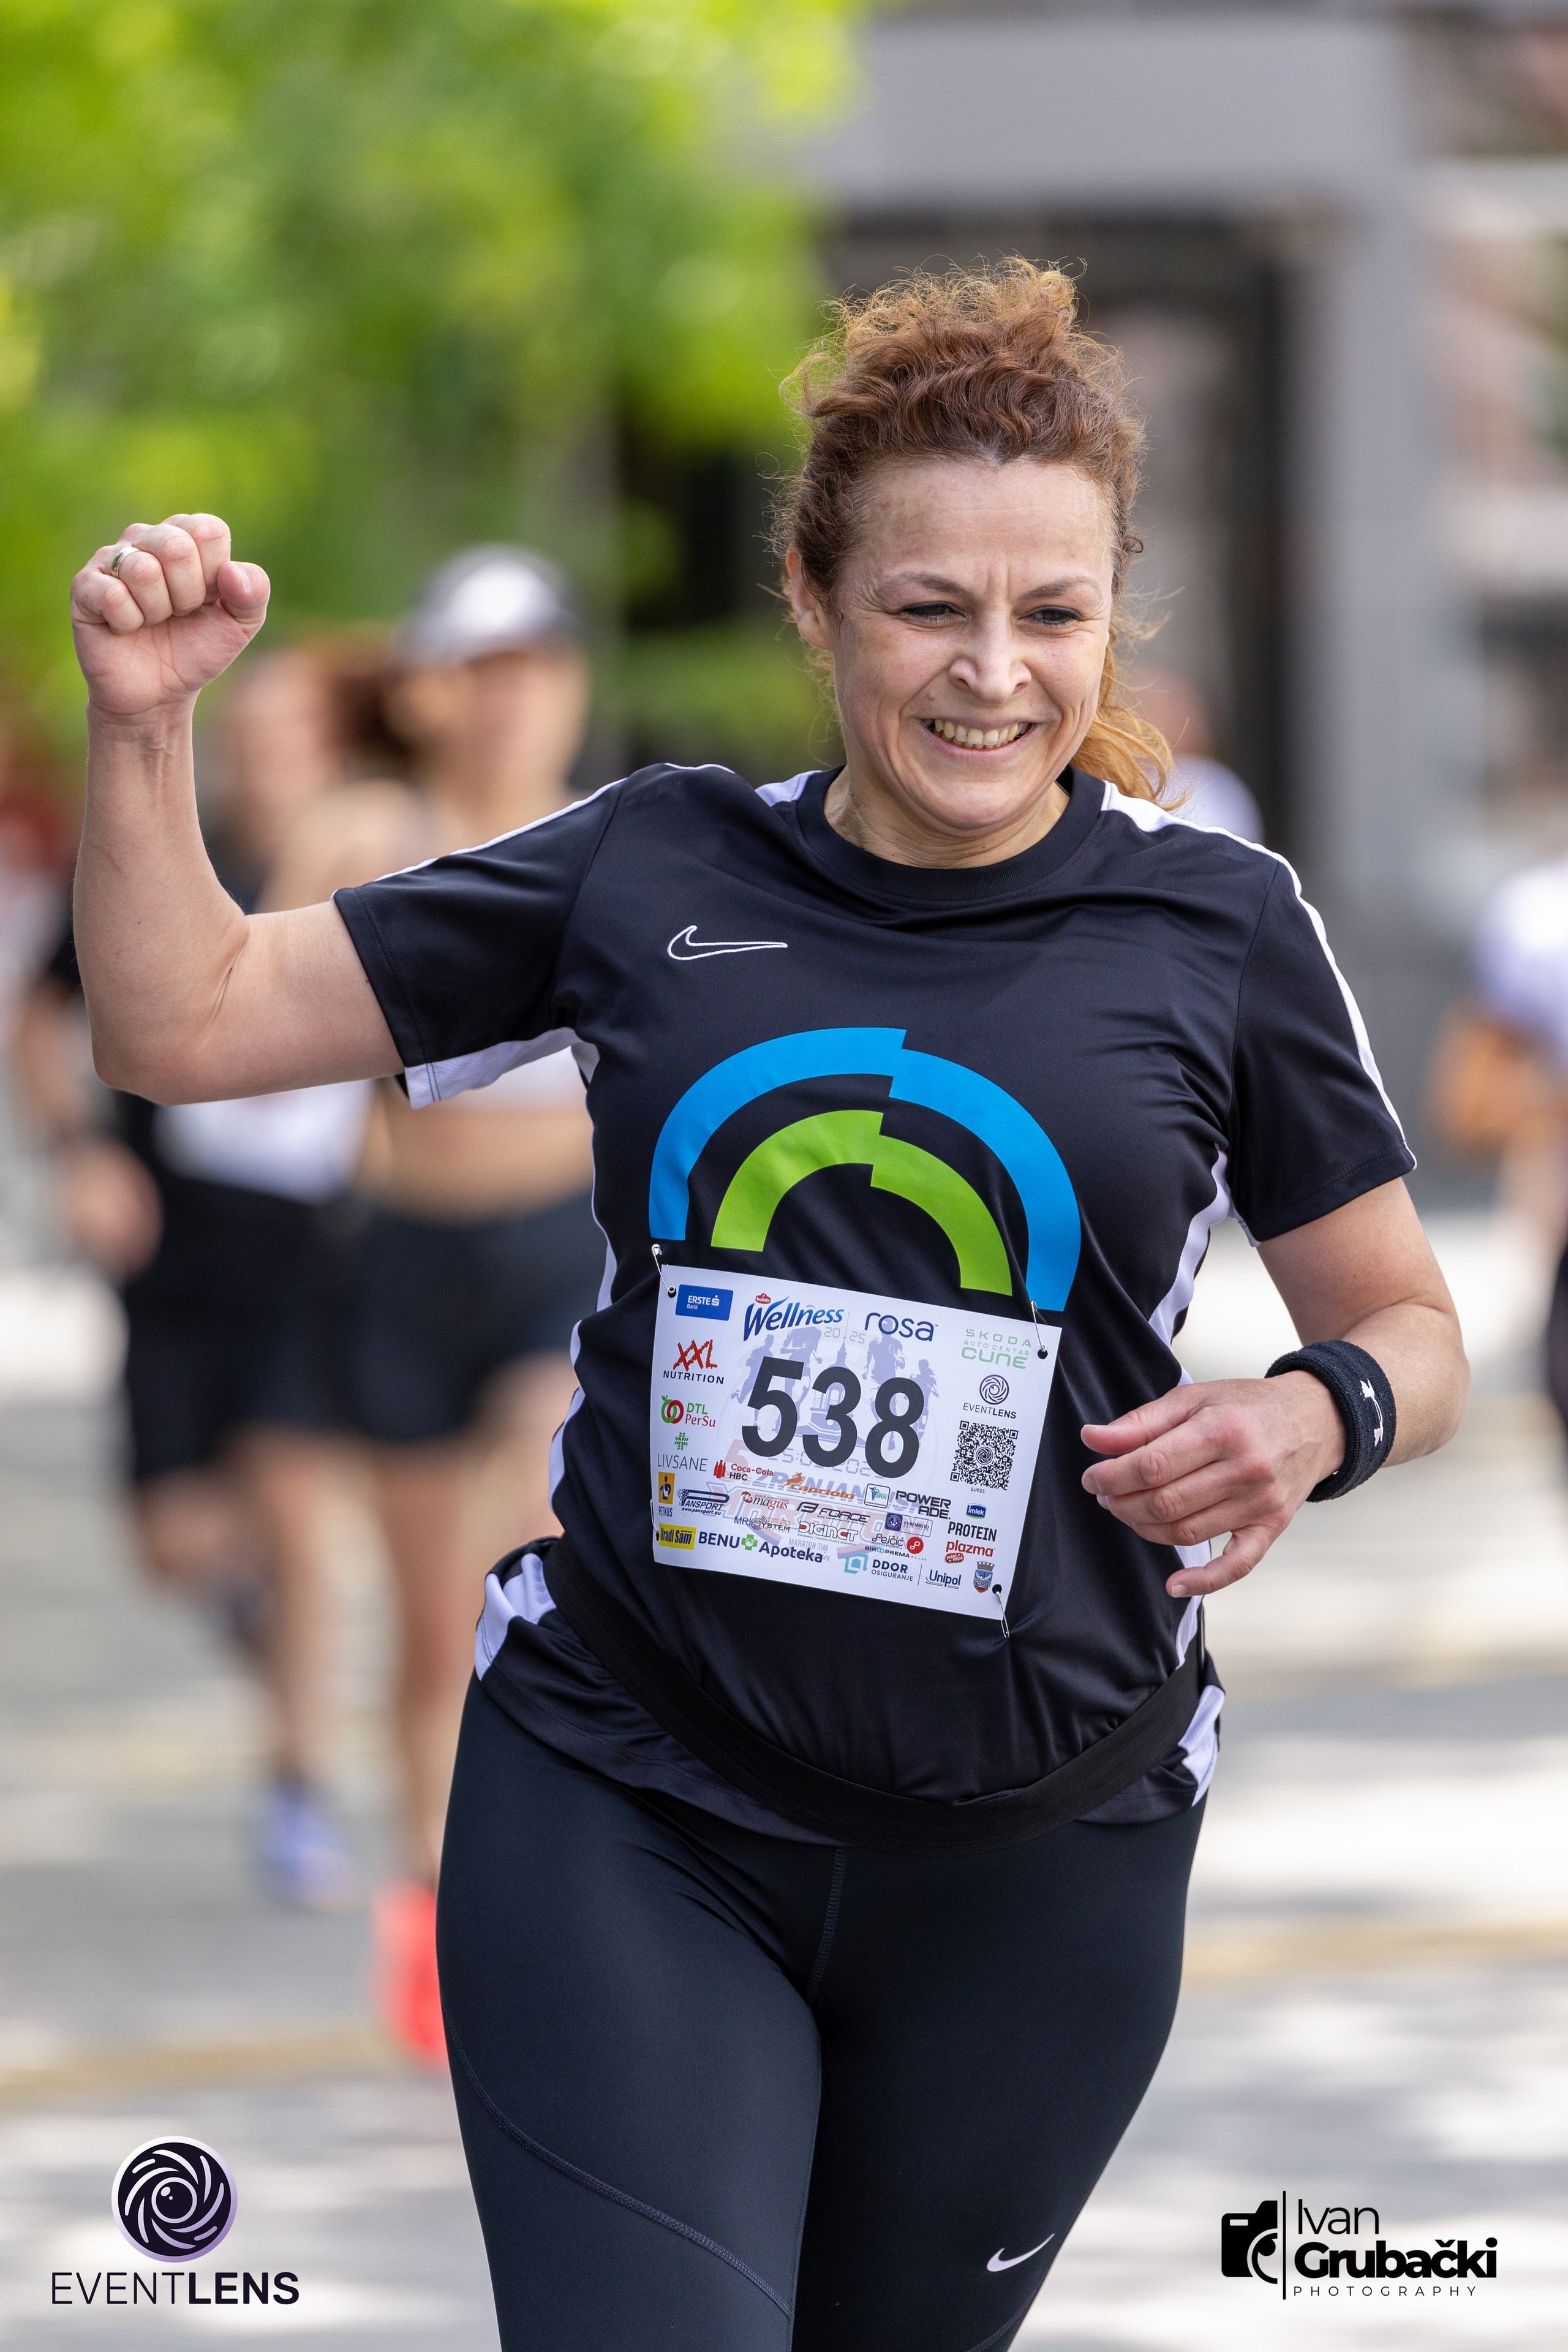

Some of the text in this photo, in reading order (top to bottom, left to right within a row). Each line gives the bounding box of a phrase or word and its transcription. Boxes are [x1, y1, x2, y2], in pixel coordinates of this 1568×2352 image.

[687, 1295, 710, 1305] ERSTE
[743, 1295, 844, 1341] Wellness
[864, 1312, 934, 1342] rosa
[673, 1339, 718, 1371] XXL
[963, 1340, 1030, 1356] AUTO CENTAR
[663, 1371, 724, 1384] NUTRITION
[687, 1403, 708, 1415] DTL
[741, 1355, 924, 1479] 538
[963, 1403, 1017, 1419] EVENTLENS
[685, 1414, 716, 1428] PerSu
[657, 1453, 708, 1472] LIVSANE
[731, 1463, 774, 1477] Coca-Cola
[729, 1472, 748, 1481] HBC
[790, 1484, 855, 1499] capriolo
[895, 1490, 951, 1509] POWER
[658, 1506, 673, 1517] PETKUS
[753, 1497, 790, 1510] magus
[968, 1506, 984, 1516] imlek
[819, 1507, 870, 1523] FORCE
[660, 1528, 692, 1545] Uradi Sam
[948, 1521, 997, 1542] PROTEIN
[698, 1531, 741, 1548] BENU
[758, 1541, 823, 1562] Apoteka
[788, 1537, 828, 1551] MARATON TIM
[946, 1539, 994, 1558] plazma
[872, 1559, 908, 1574] DDOR
[871, 1569, 914, 1581] OSIGURANJE
[929, 1569, 962, 1587] Unipol
